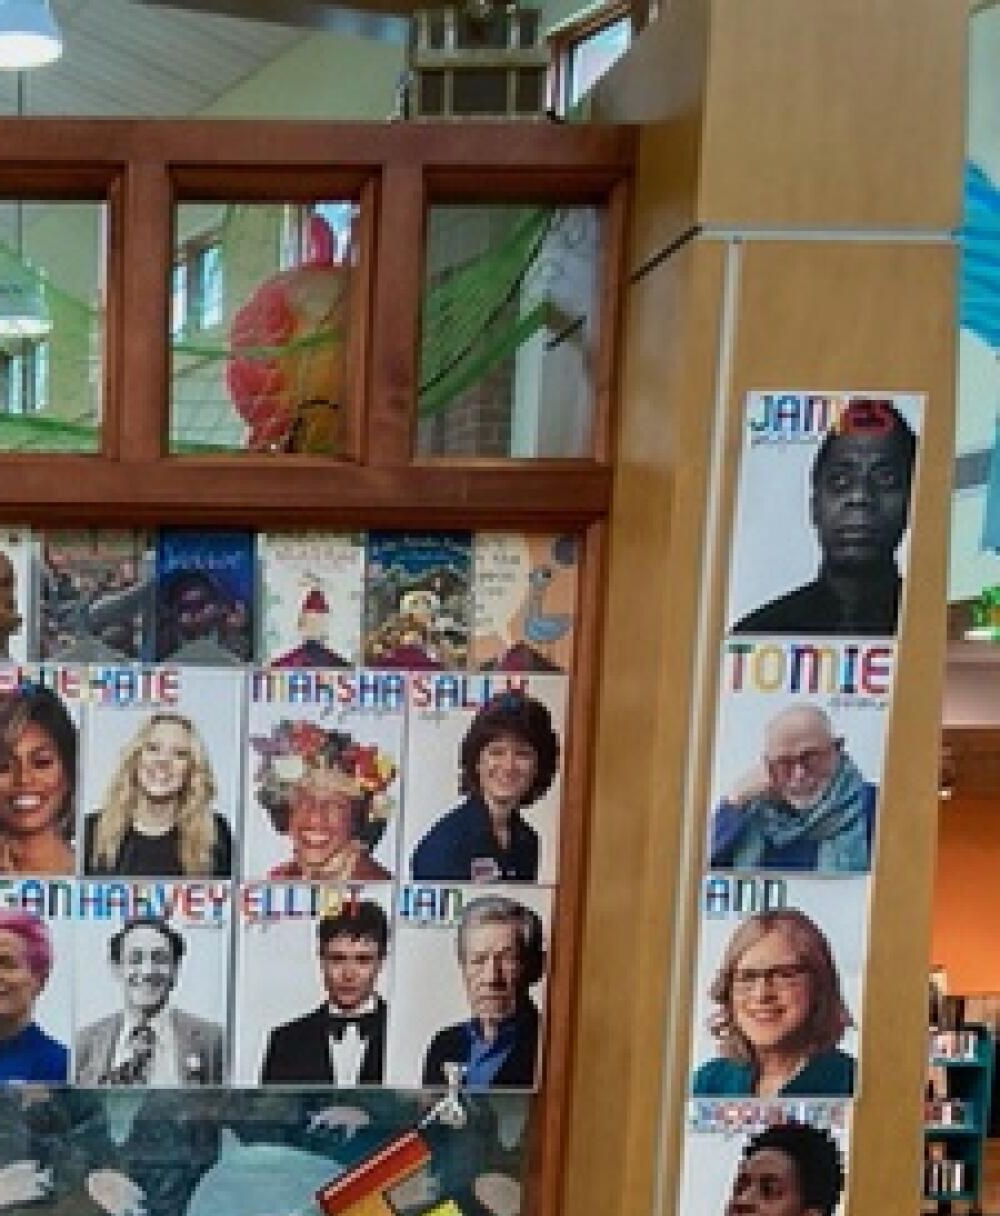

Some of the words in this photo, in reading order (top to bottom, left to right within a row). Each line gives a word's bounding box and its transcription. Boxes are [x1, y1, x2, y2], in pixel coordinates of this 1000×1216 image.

[728, 644, 890, 693] TOMIE
[77, 881, 229, 921] HARVEY
[399, 887, 465, 919] IAN
[706, 879, 787, 911] ANN
